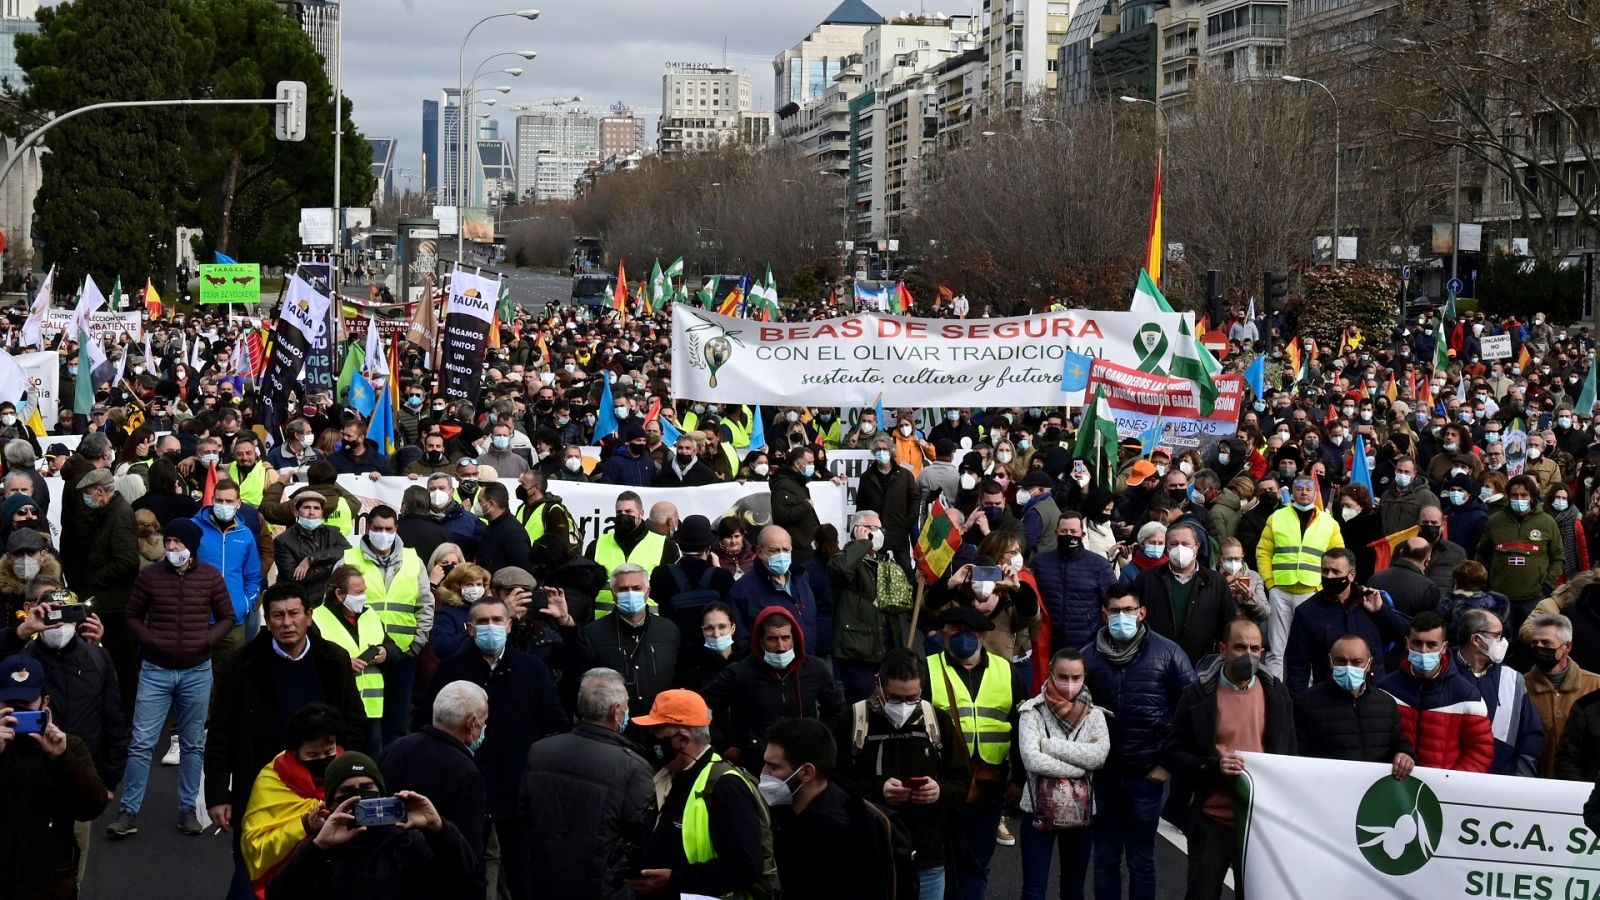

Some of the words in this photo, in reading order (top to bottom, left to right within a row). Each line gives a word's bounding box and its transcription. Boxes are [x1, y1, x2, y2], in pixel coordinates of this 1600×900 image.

[453, 294, 490, 312] FAUNA
[759, 318, 864, 342] BEAS
[877, 318, 928, 339] DE
[940, 317, 1104, 339] SEGURA
[756, 346, 809, 361] CON
[818, 346, 846, 361] EL
[853, 345, 940, 361] OLIVAR
[892, 366, 973, 385] cultura
[973, 375, 996, 392] y
[995, 366, 1063, 389] futuro
[1092, 364, 1107, 378] SIN
[1105, 367, 1153, 391] GANADEROS
[1214, 380, 1240, 394] COMEN
[446, 387, 468, 399] ODOS
[1136, 391, 1171, 407] TRAIDOR
[1171, 394, 1197, 409] GARZ
[1113, 417, 1149, 431] ARNES
[1173, 419, 1217, 434] UBIÑAS
[1457, 817, 1555, 853] S.C.A.
[1464, 870, 1554, 900] SILES
